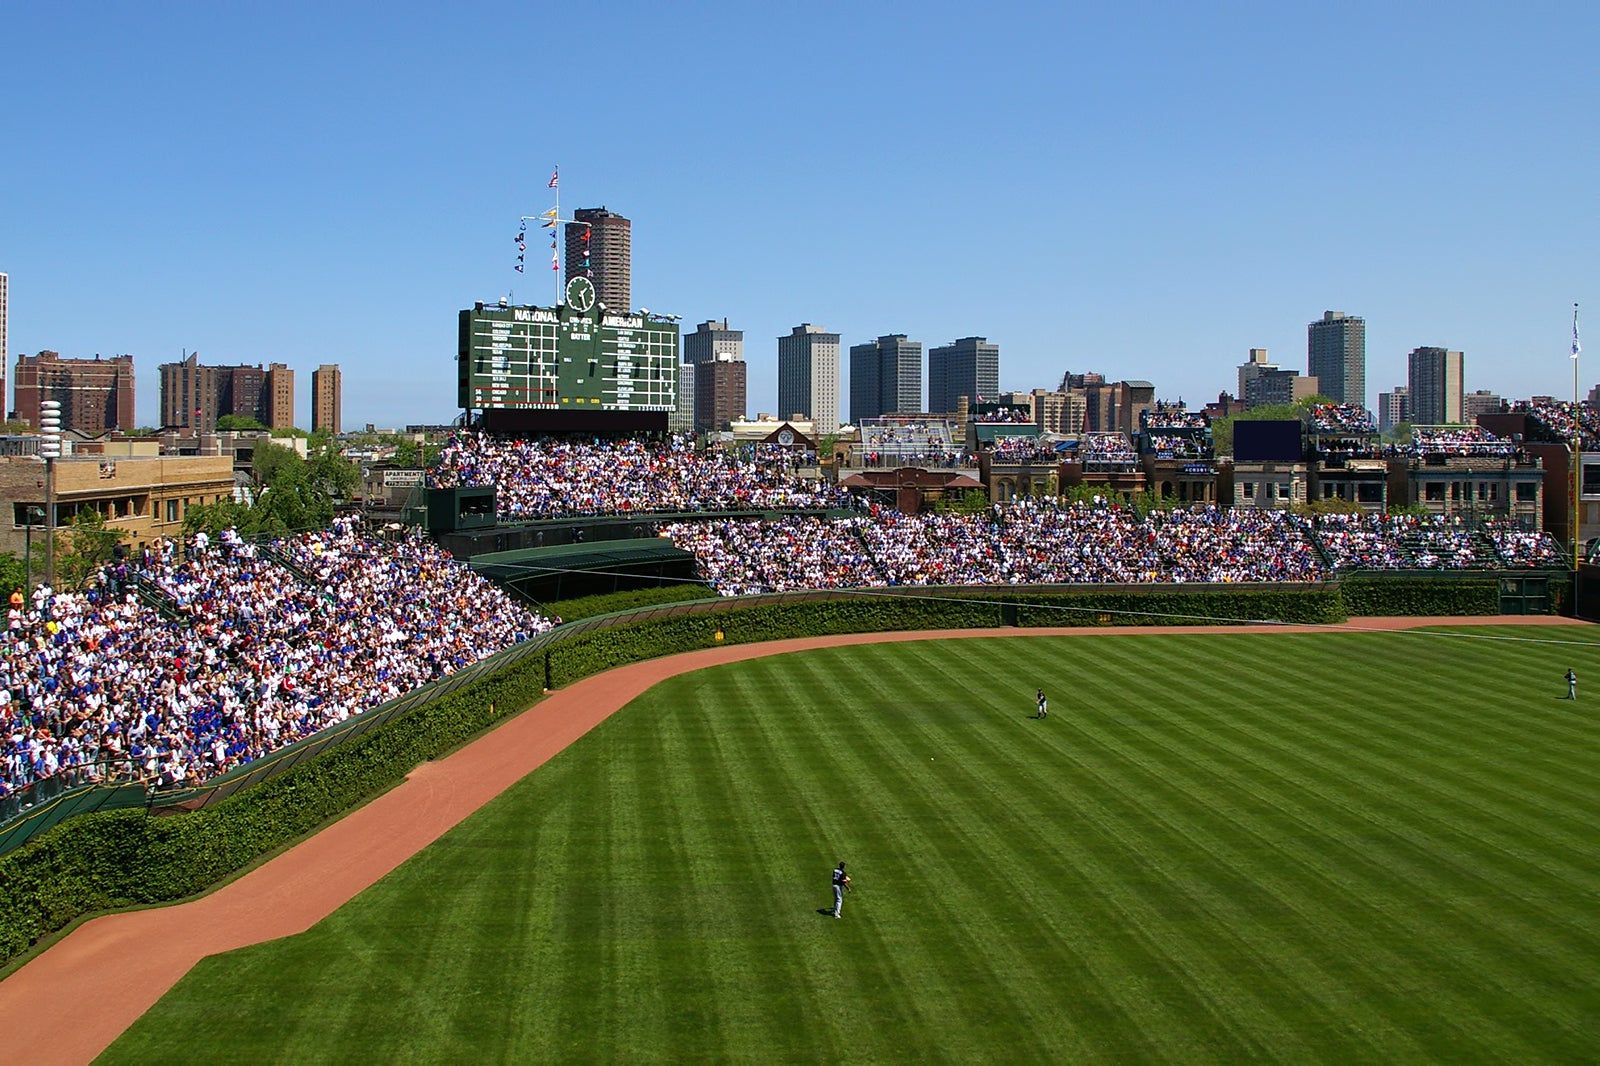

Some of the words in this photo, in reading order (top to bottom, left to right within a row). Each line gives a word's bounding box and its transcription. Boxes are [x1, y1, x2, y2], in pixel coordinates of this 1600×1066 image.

[514, 309, 559, 322] NATIONAL
[602, 316, 643, 328] AMERICAN
[571, 333, 591, 341] BATTER
